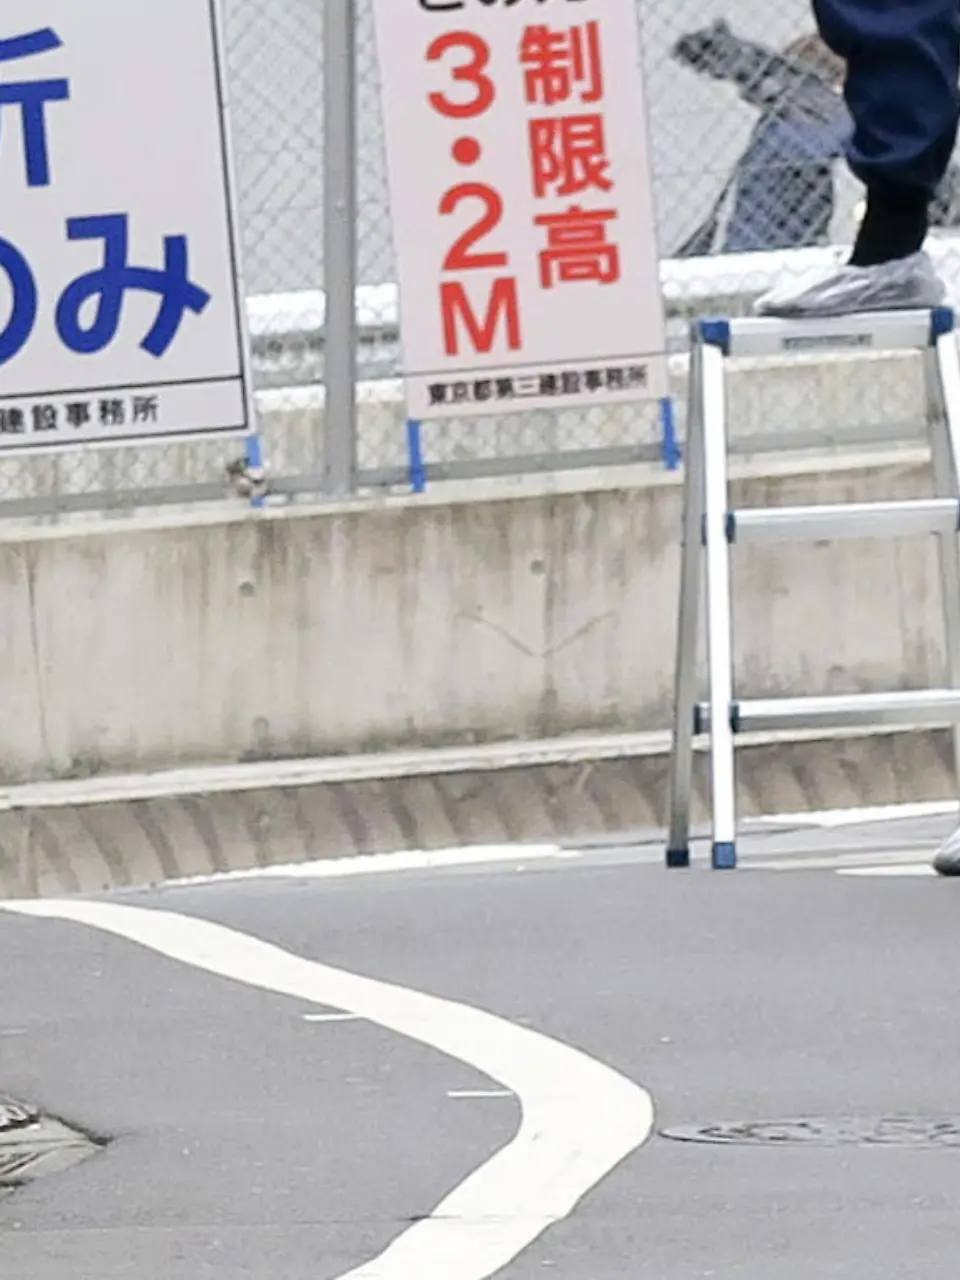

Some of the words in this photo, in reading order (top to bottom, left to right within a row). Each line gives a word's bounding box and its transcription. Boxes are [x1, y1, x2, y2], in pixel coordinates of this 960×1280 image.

[519, 21, 620, 290] 制限高
[0, 213, 211, 368] み
